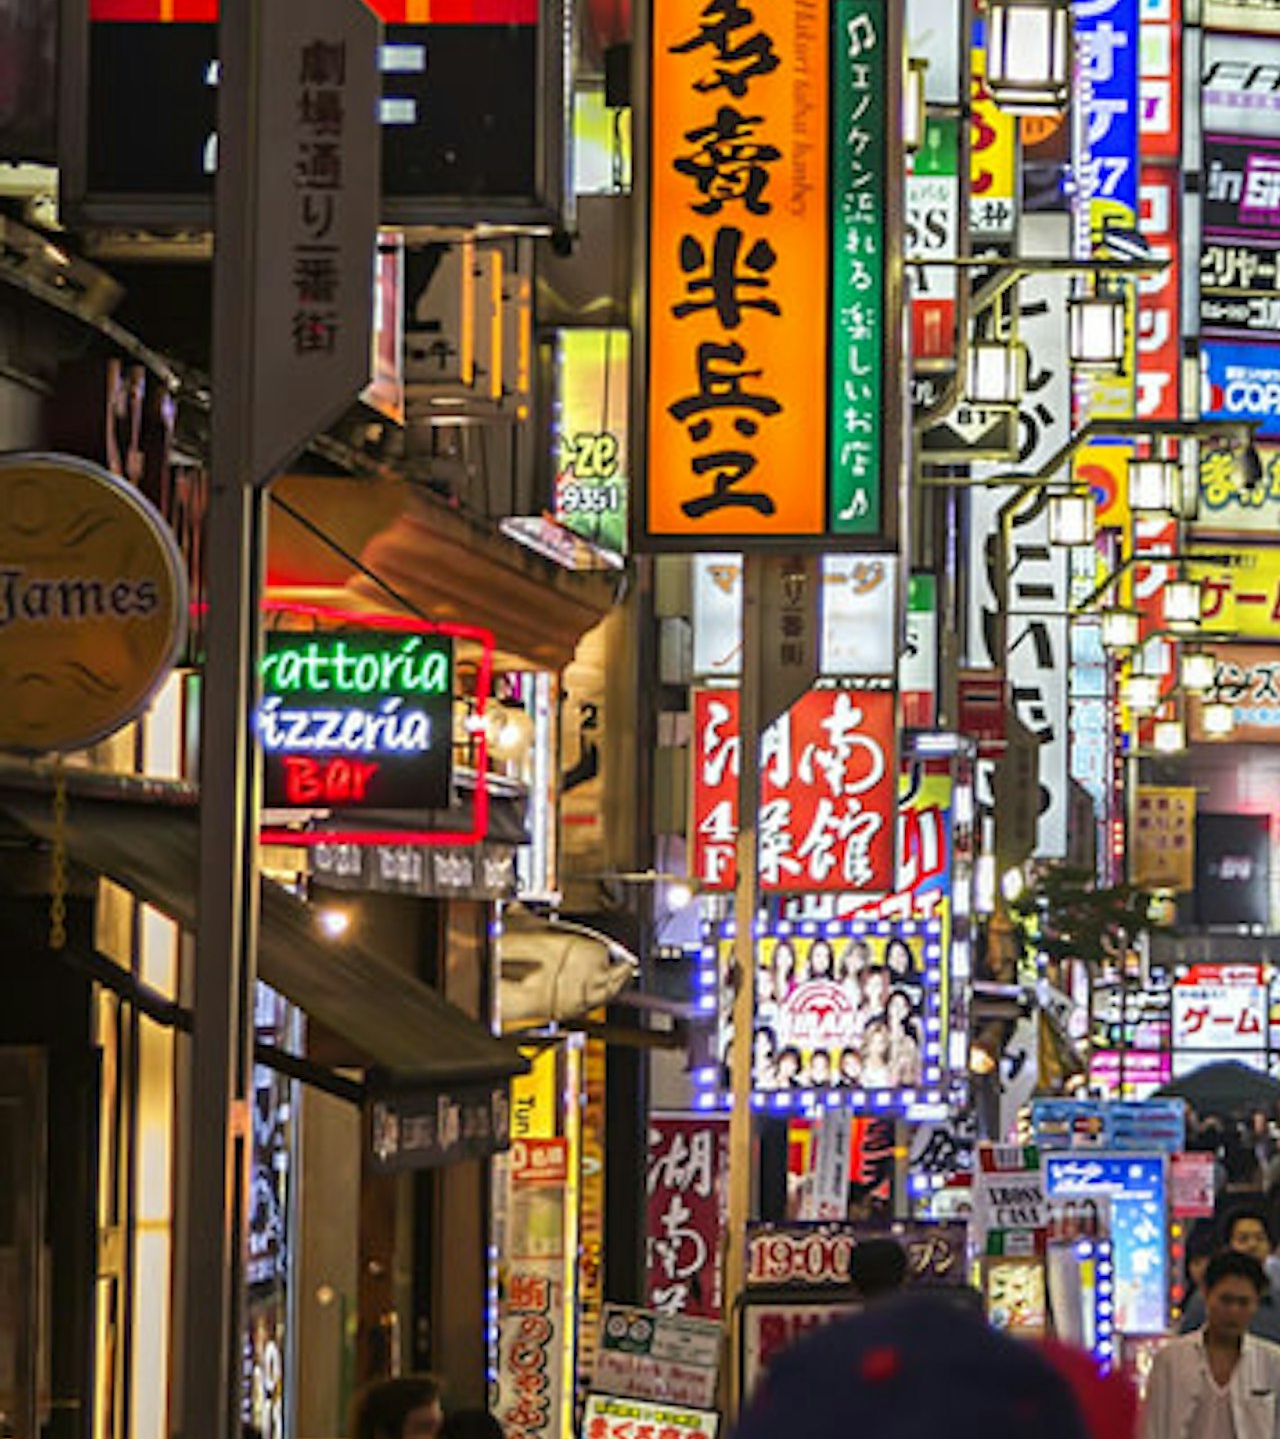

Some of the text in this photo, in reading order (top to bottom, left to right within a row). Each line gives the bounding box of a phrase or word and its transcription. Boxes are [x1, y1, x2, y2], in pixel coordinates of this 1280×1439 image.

[262, 637, 448, 695] rattoria
[262, 705, 432, 753] izzeria
[286, 755, 376, 805] Bar
[750, 1237, 854, 1283] 19:00
